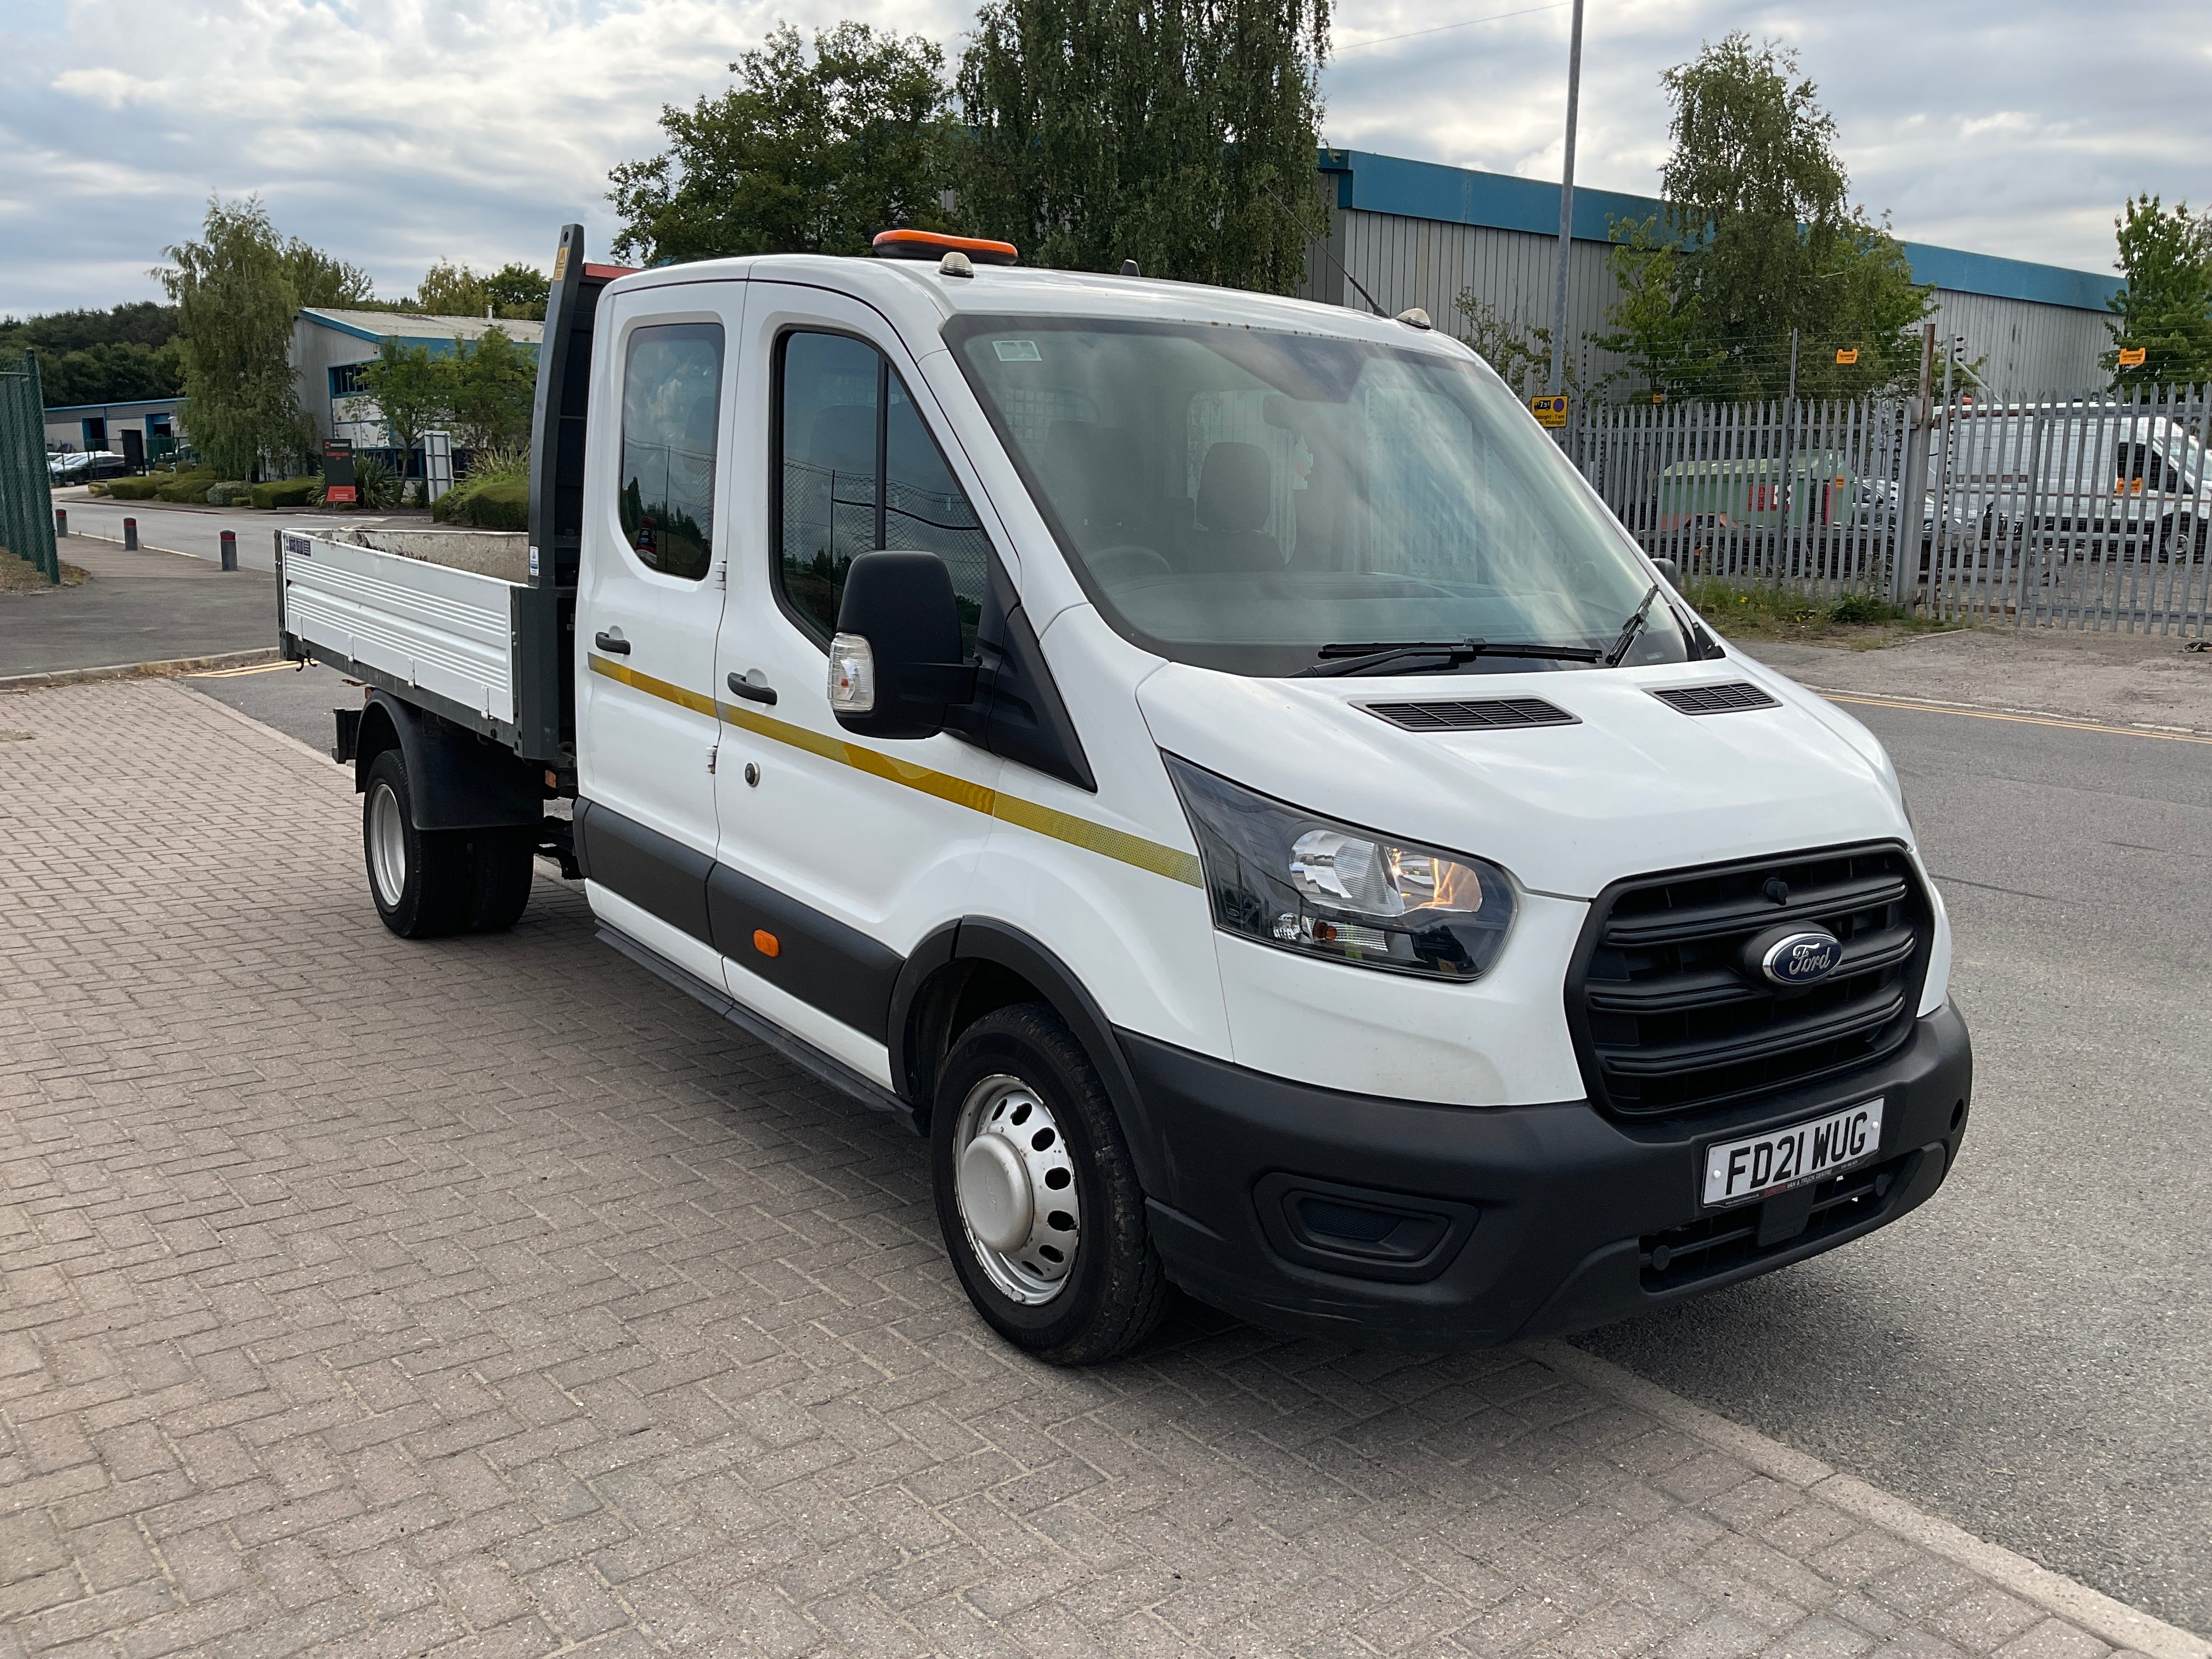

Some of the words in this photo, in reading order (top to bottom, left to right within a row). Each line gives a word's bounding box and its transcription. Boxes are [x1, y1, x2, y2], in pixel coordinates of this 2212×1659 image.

[1789, 943, 1831, 975] Ford
[1725, 1132, 1804, 1195] FD21
[1812, 1111, 1867, 1171] WUG
[1787, 1181, 1796, 1189] VAN
[1801, 1175, 1815, 1184] TRUCK
[1815, 1169, 1832, 1179] CENTRE
